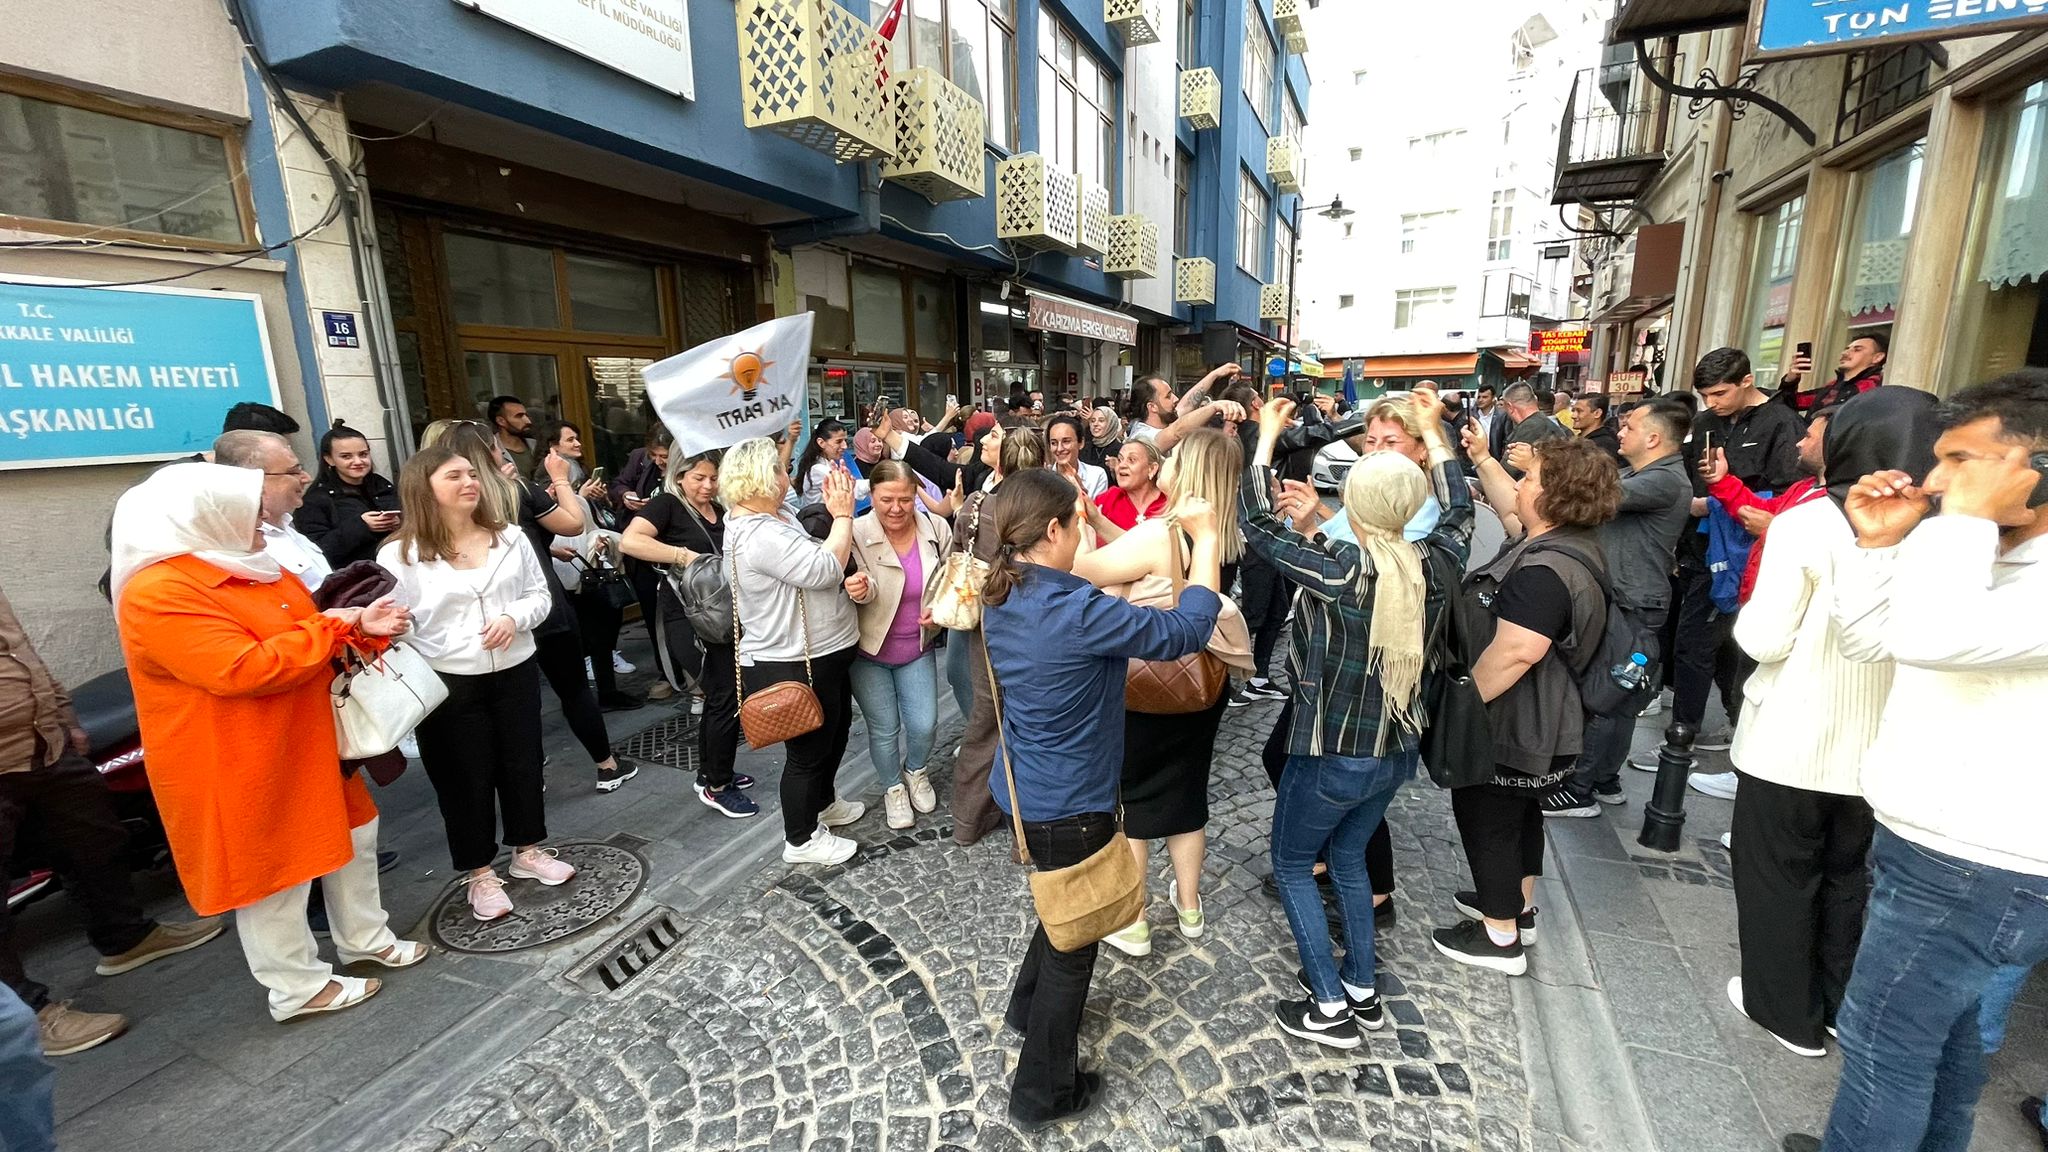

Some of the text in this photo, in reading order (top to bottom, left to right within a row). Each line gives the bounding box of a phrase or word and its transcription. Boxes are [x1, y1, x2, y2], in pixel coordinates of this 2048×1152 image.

[612, 8, 682, 53] MÜDÜRLÜĞÜ
[17, 302, 55, 319] T.C.
[59, 326, 135, 344] VALİLİĞİ
[333, 322, 350, 335] 16
[30, 363, 143, 388] HAKEM
[149, 361, 240, 388] HEYETİ
[1615, 382, 1629, 392] 30
